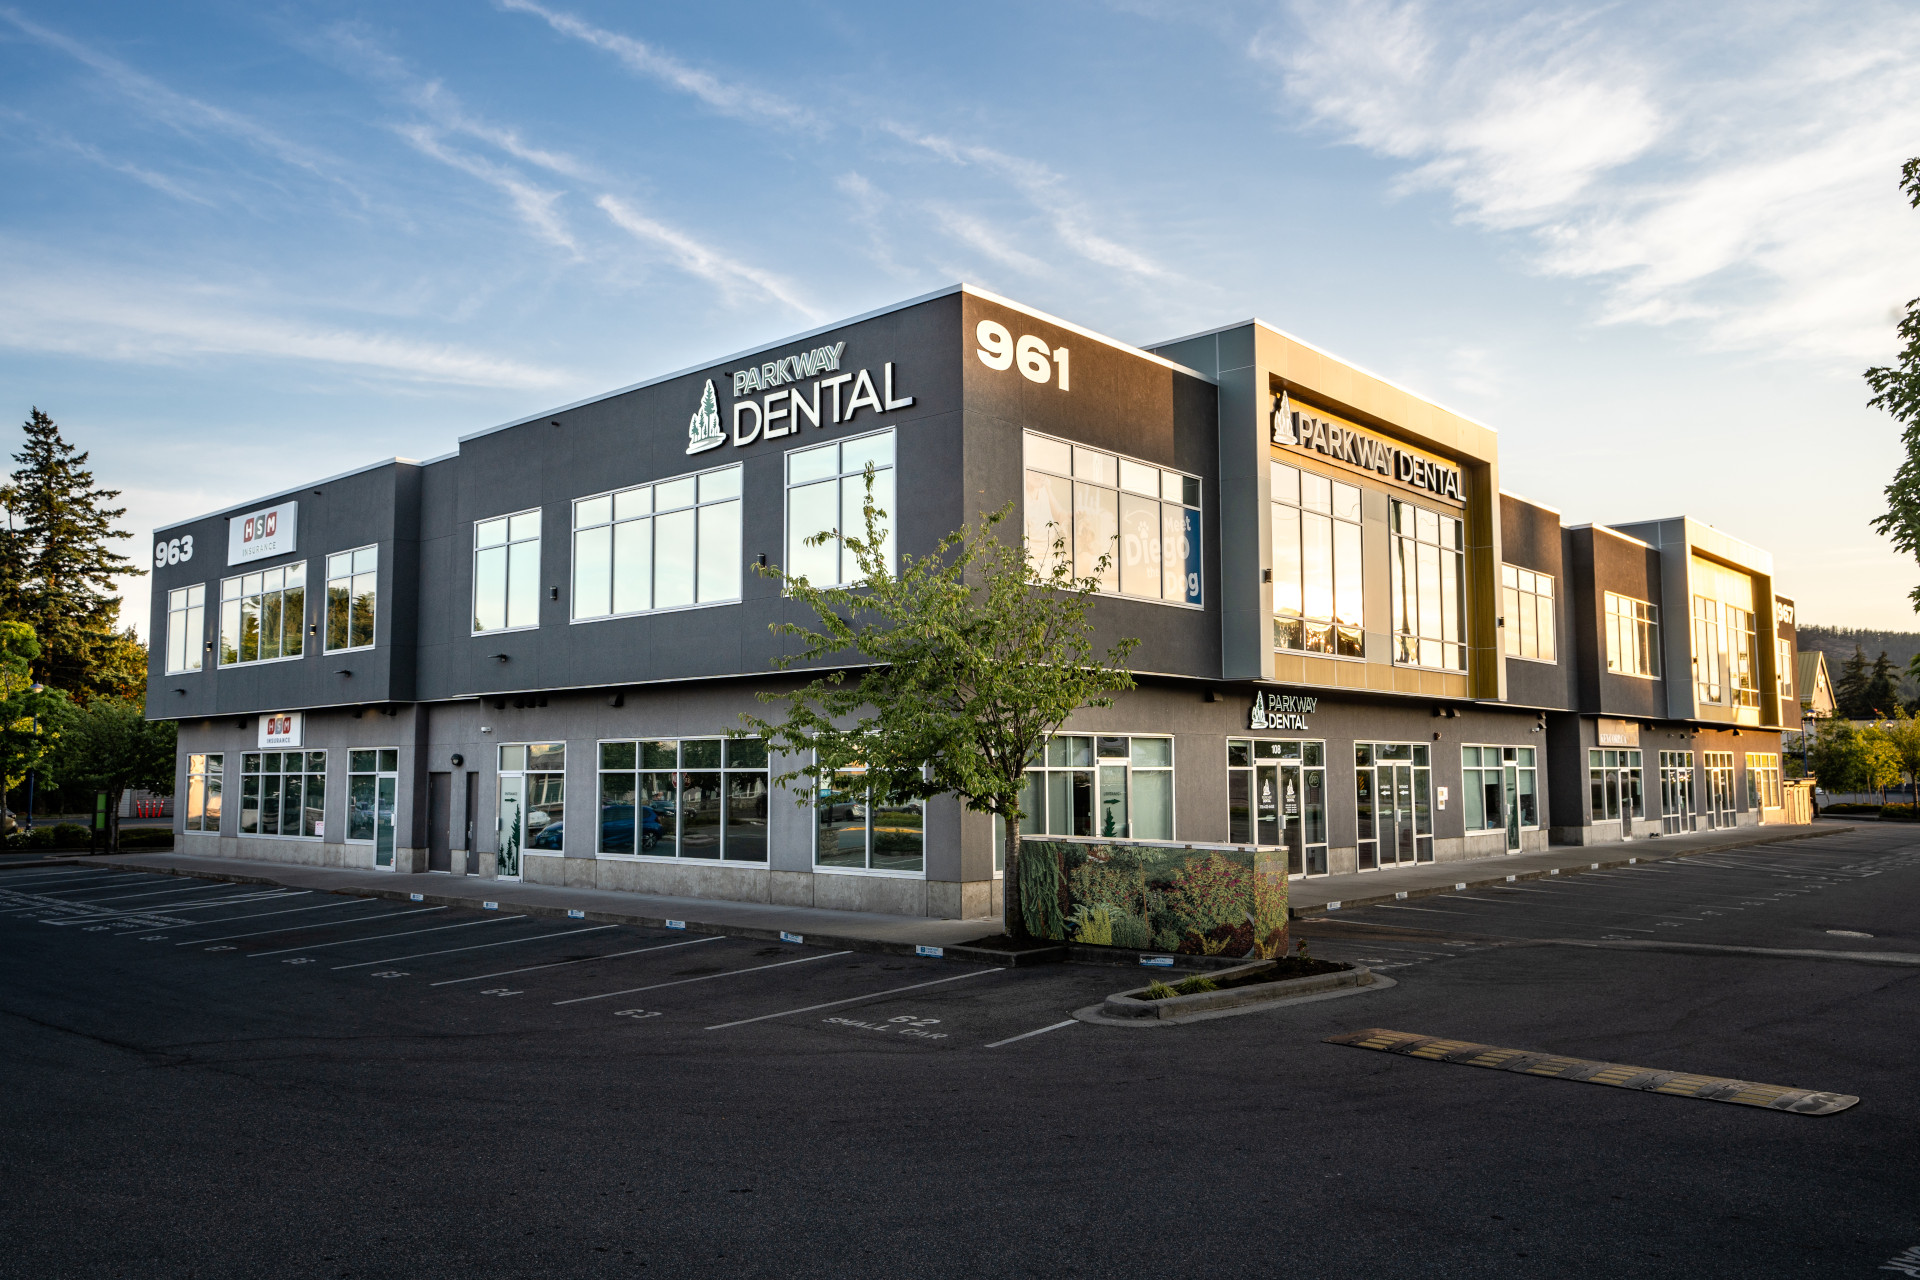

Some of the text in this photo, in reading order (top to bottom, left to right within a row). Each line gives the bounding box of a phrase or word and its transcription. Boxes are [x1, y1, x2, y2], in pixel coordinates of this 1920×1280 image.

[976, 319, 1069, 391] 961
[733, 341, 846, 397] PARKWAY
[733, 362, 916, 447] DENTAL
[1294, 411, 1466, 503] PARKWAY DENTAL
[244, 513, 277, 541] HSM
[1164, 515, 1191, 533] Meet
[155, 535, 193, 568] 963
[242, 541, 276, 557] INSURANCE
[1125, 533, 1190, 568] Diego
[1165, 570, 1199, 597] Dog
[1268, 693, 1317, 713] PARKWAY
[268, 718, 290, 734] HSM
[1268, 713, 1308, 730] DENTAL
[480, 988, 525, 997] 64
[613, 1008, 662, 1019] 63
[887, 1015, 941, 1027] 62
[822, 1017, 948, 1040] SMALL CAR
